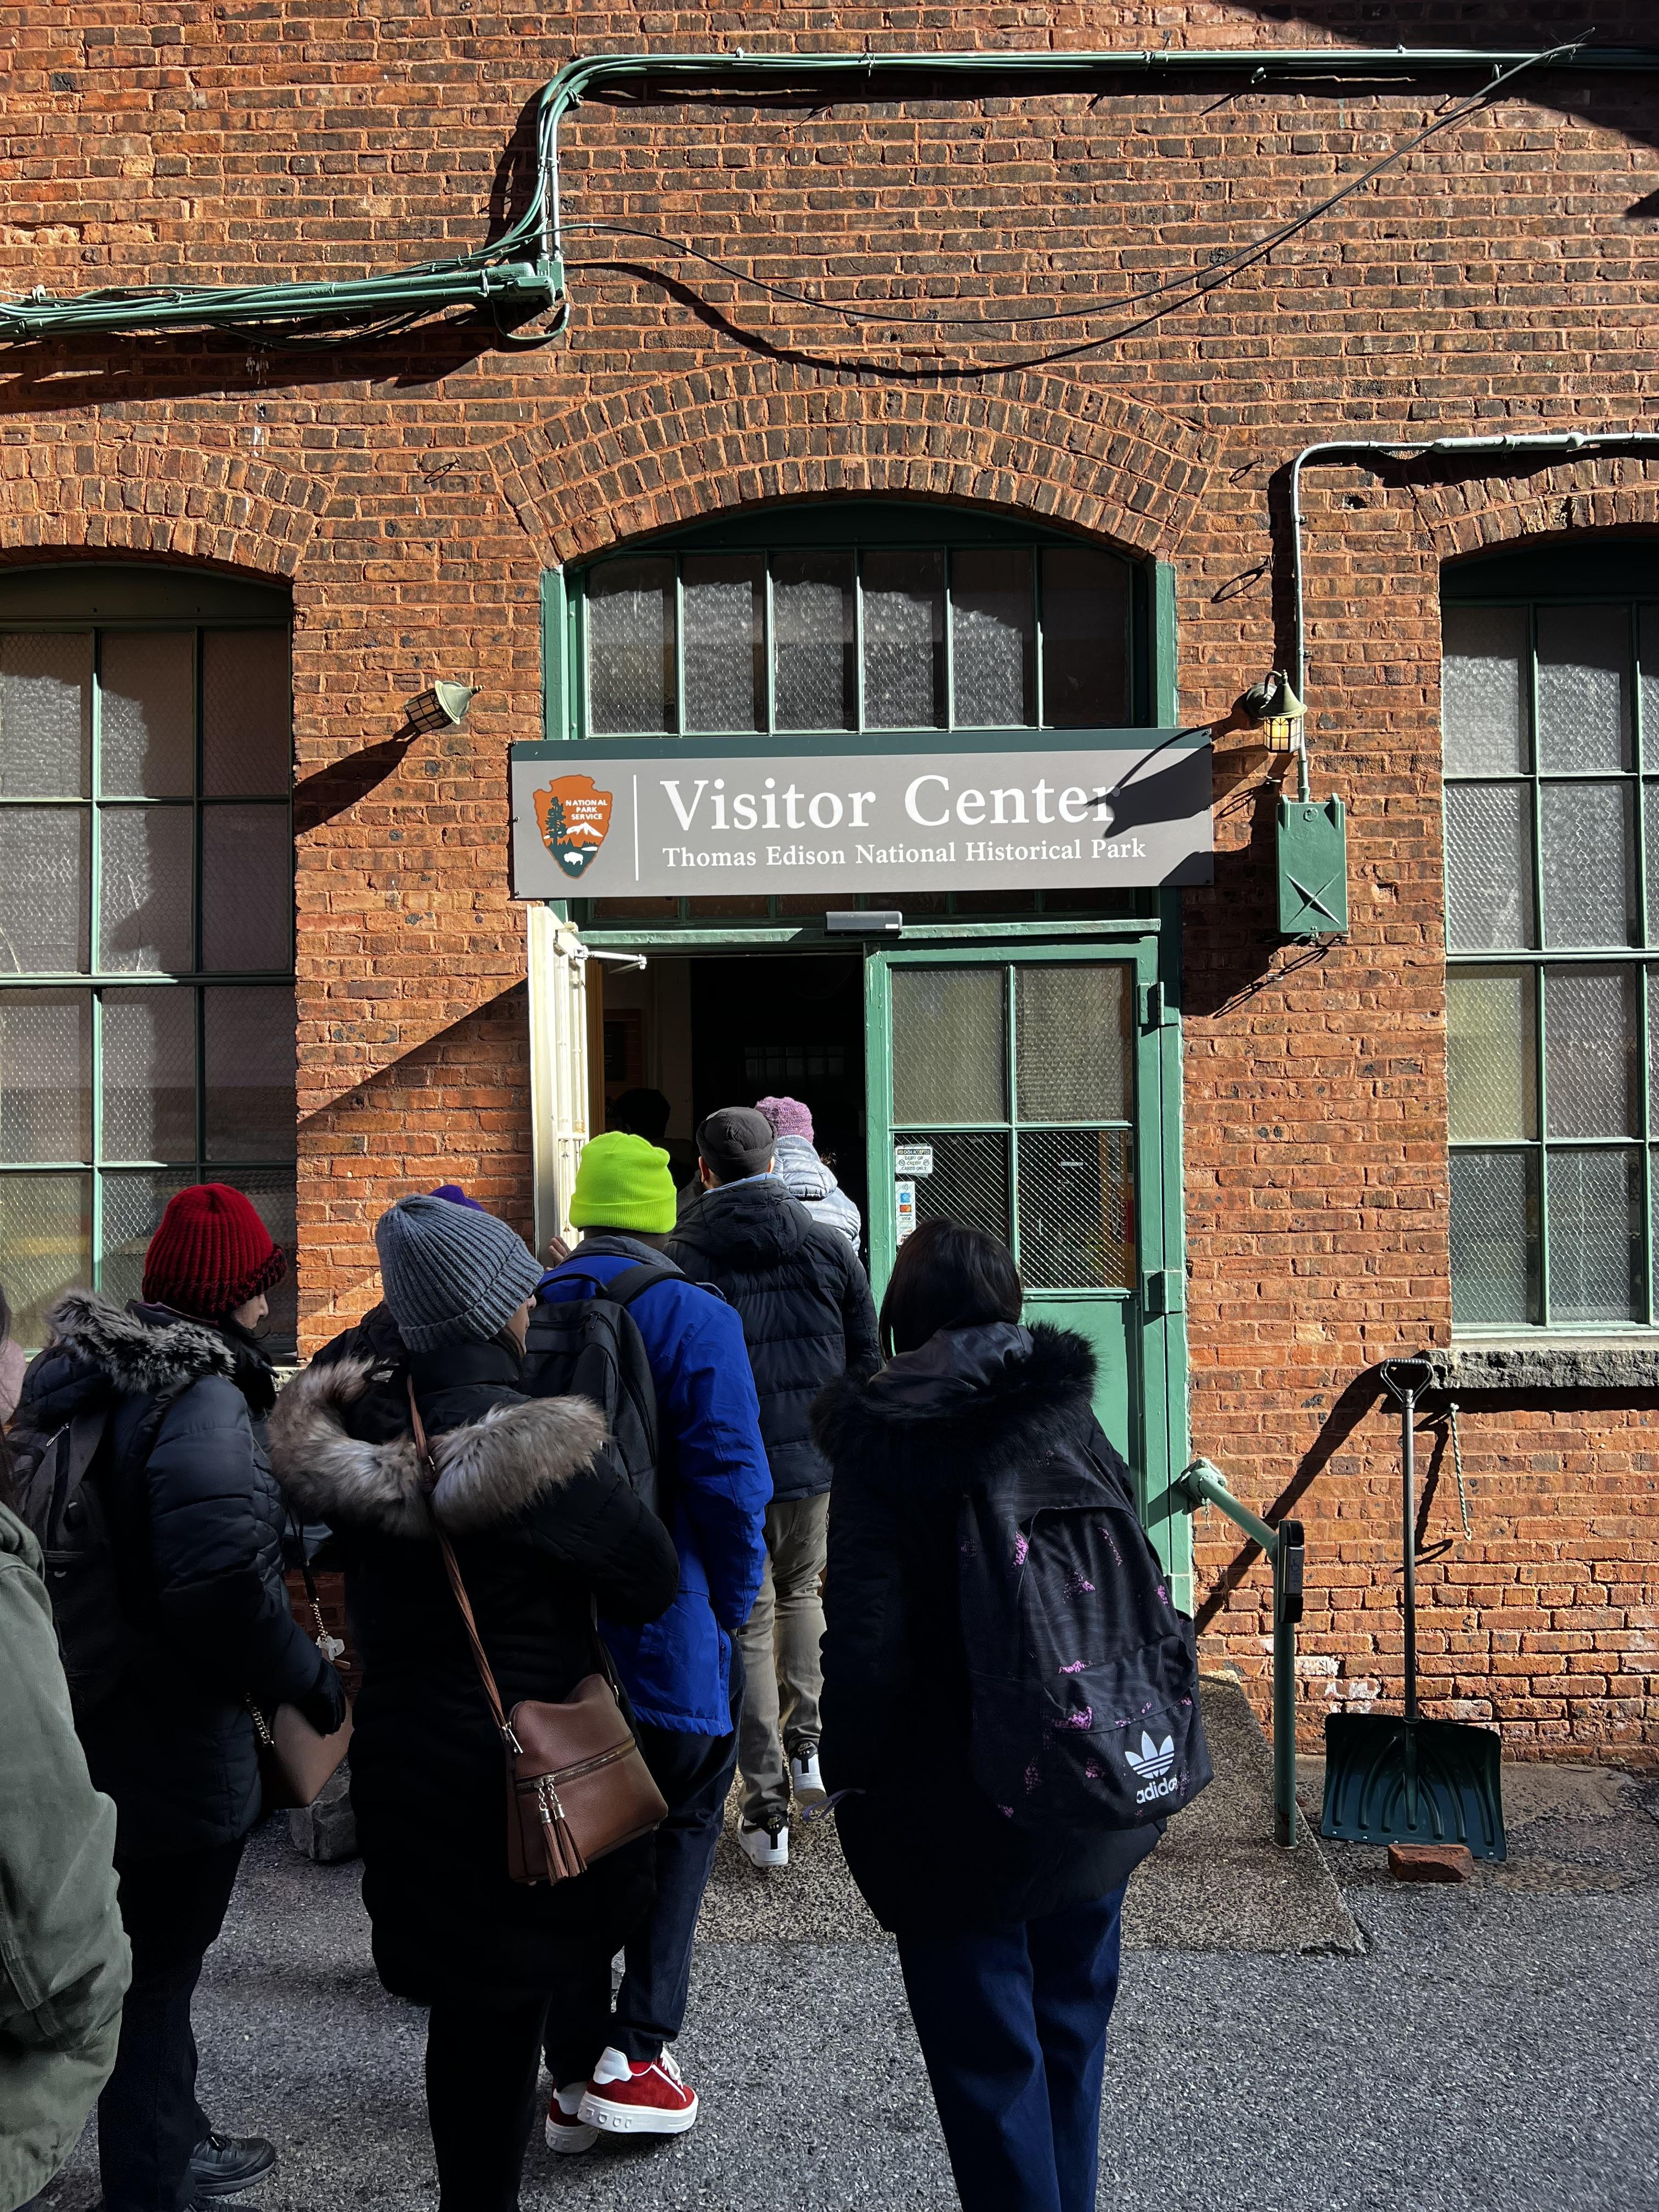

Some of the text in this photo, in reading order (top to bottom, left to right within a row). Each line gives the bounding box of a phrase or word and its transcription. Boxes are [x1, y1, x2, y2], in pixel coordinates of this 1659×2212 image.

[659, 774, 1121, 831] Visitor Center
[662, 837, 1147, 867] Thomas Edison National Historical Park
[1136, 1777, 1178, 1804] adida
